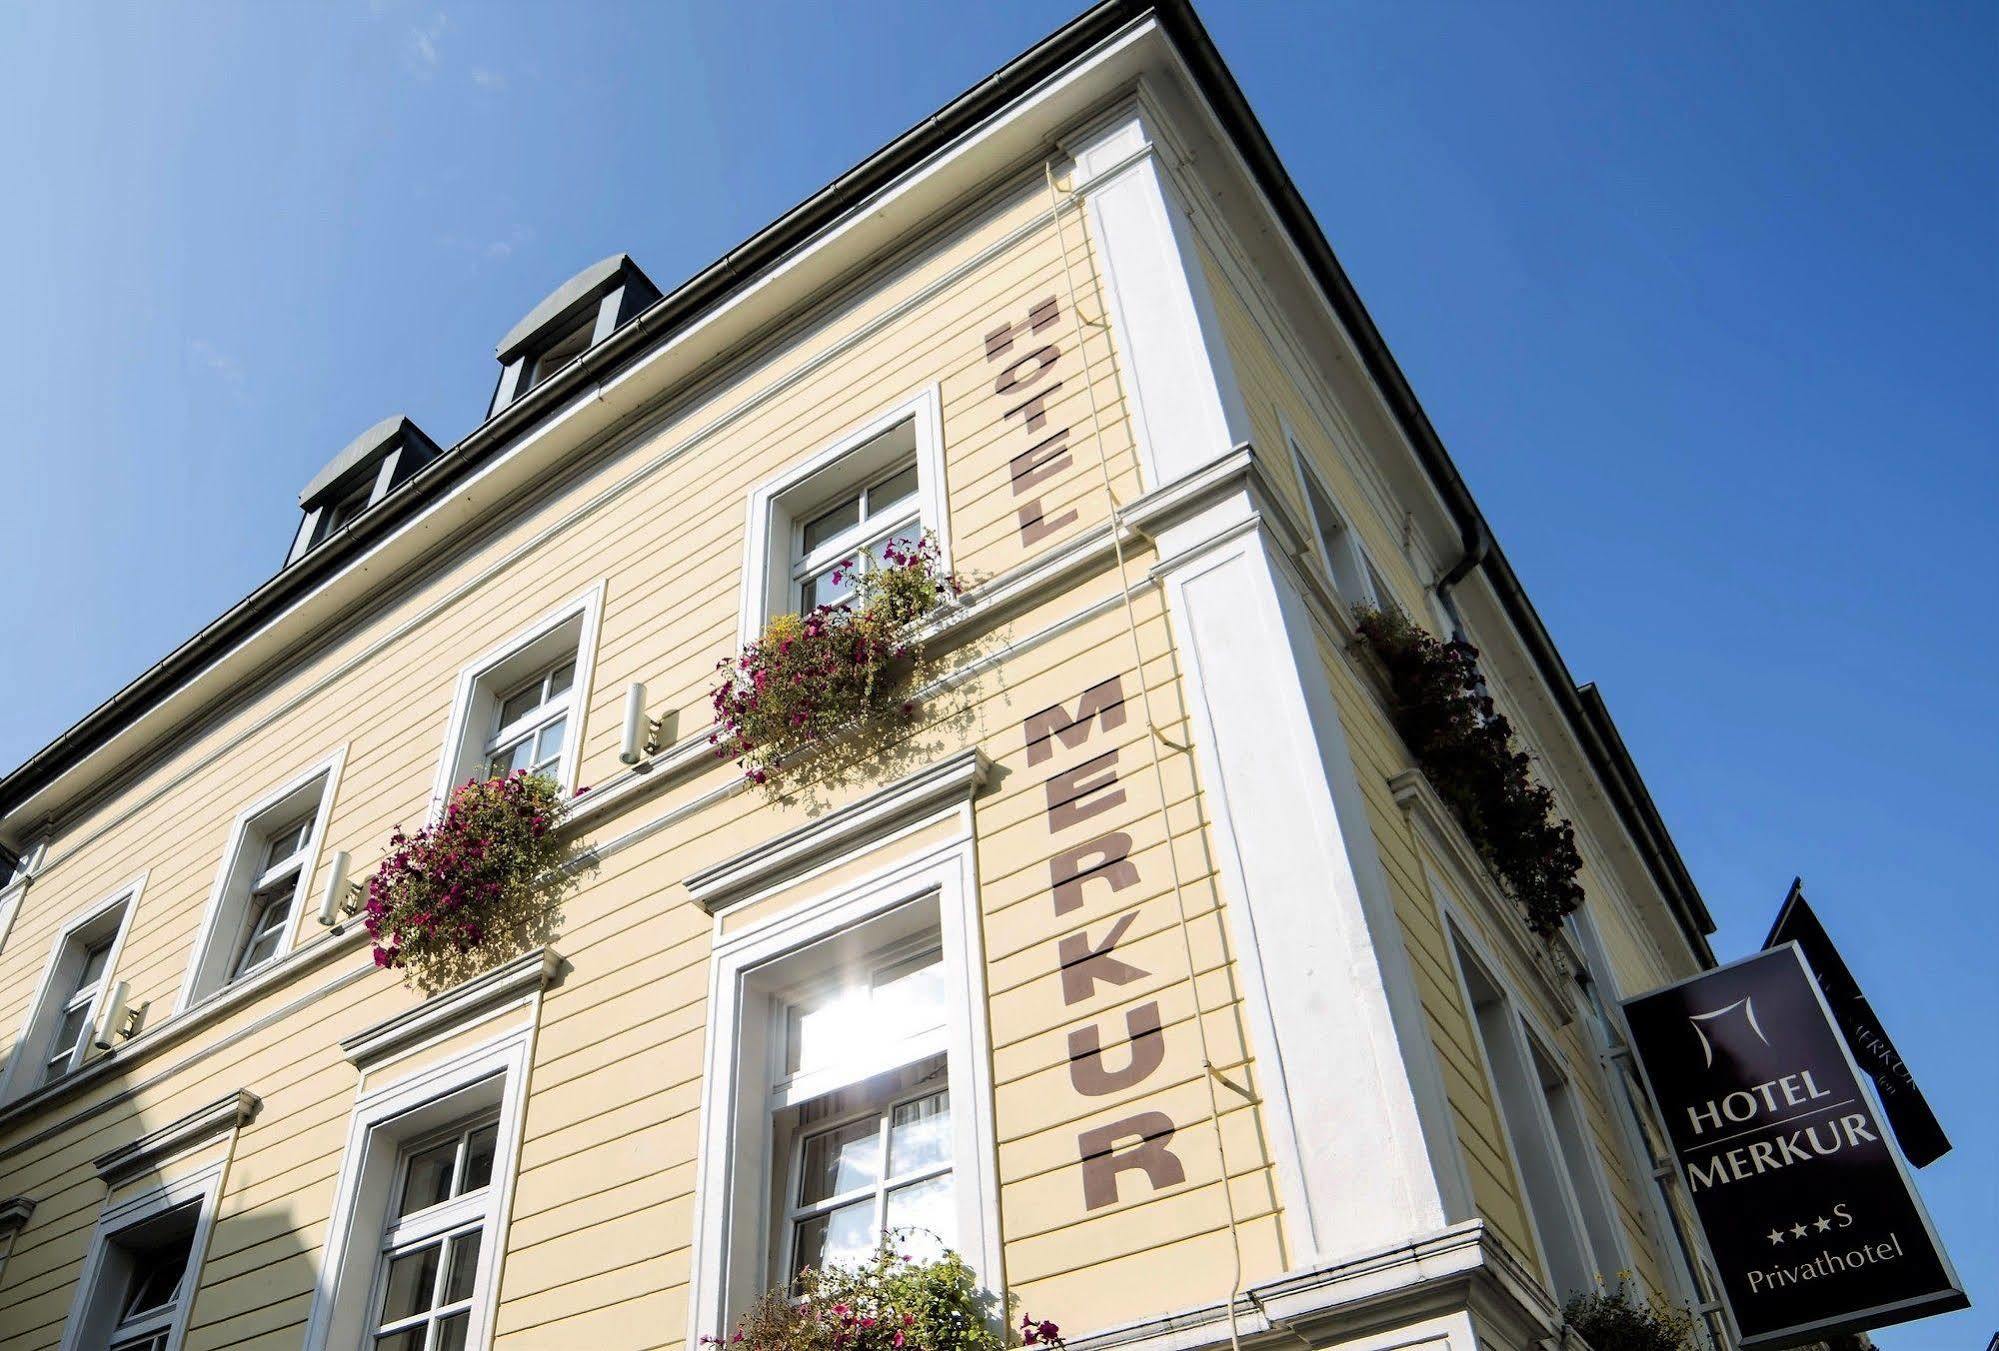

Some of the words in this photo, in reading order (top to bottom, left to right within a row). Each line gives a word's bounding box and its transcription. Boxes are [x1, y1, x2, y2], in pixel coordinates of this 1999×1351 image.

[985, 294, 1078, 548] HOTEL
[1024, 675, 1186, 1211] MERKUR
[1687, 1070, 1831, 1134] HOTEL
[1687, 1113, 1877, 1192] MERKUR
[1747, 1233, 1904, 1294] Privathotel
